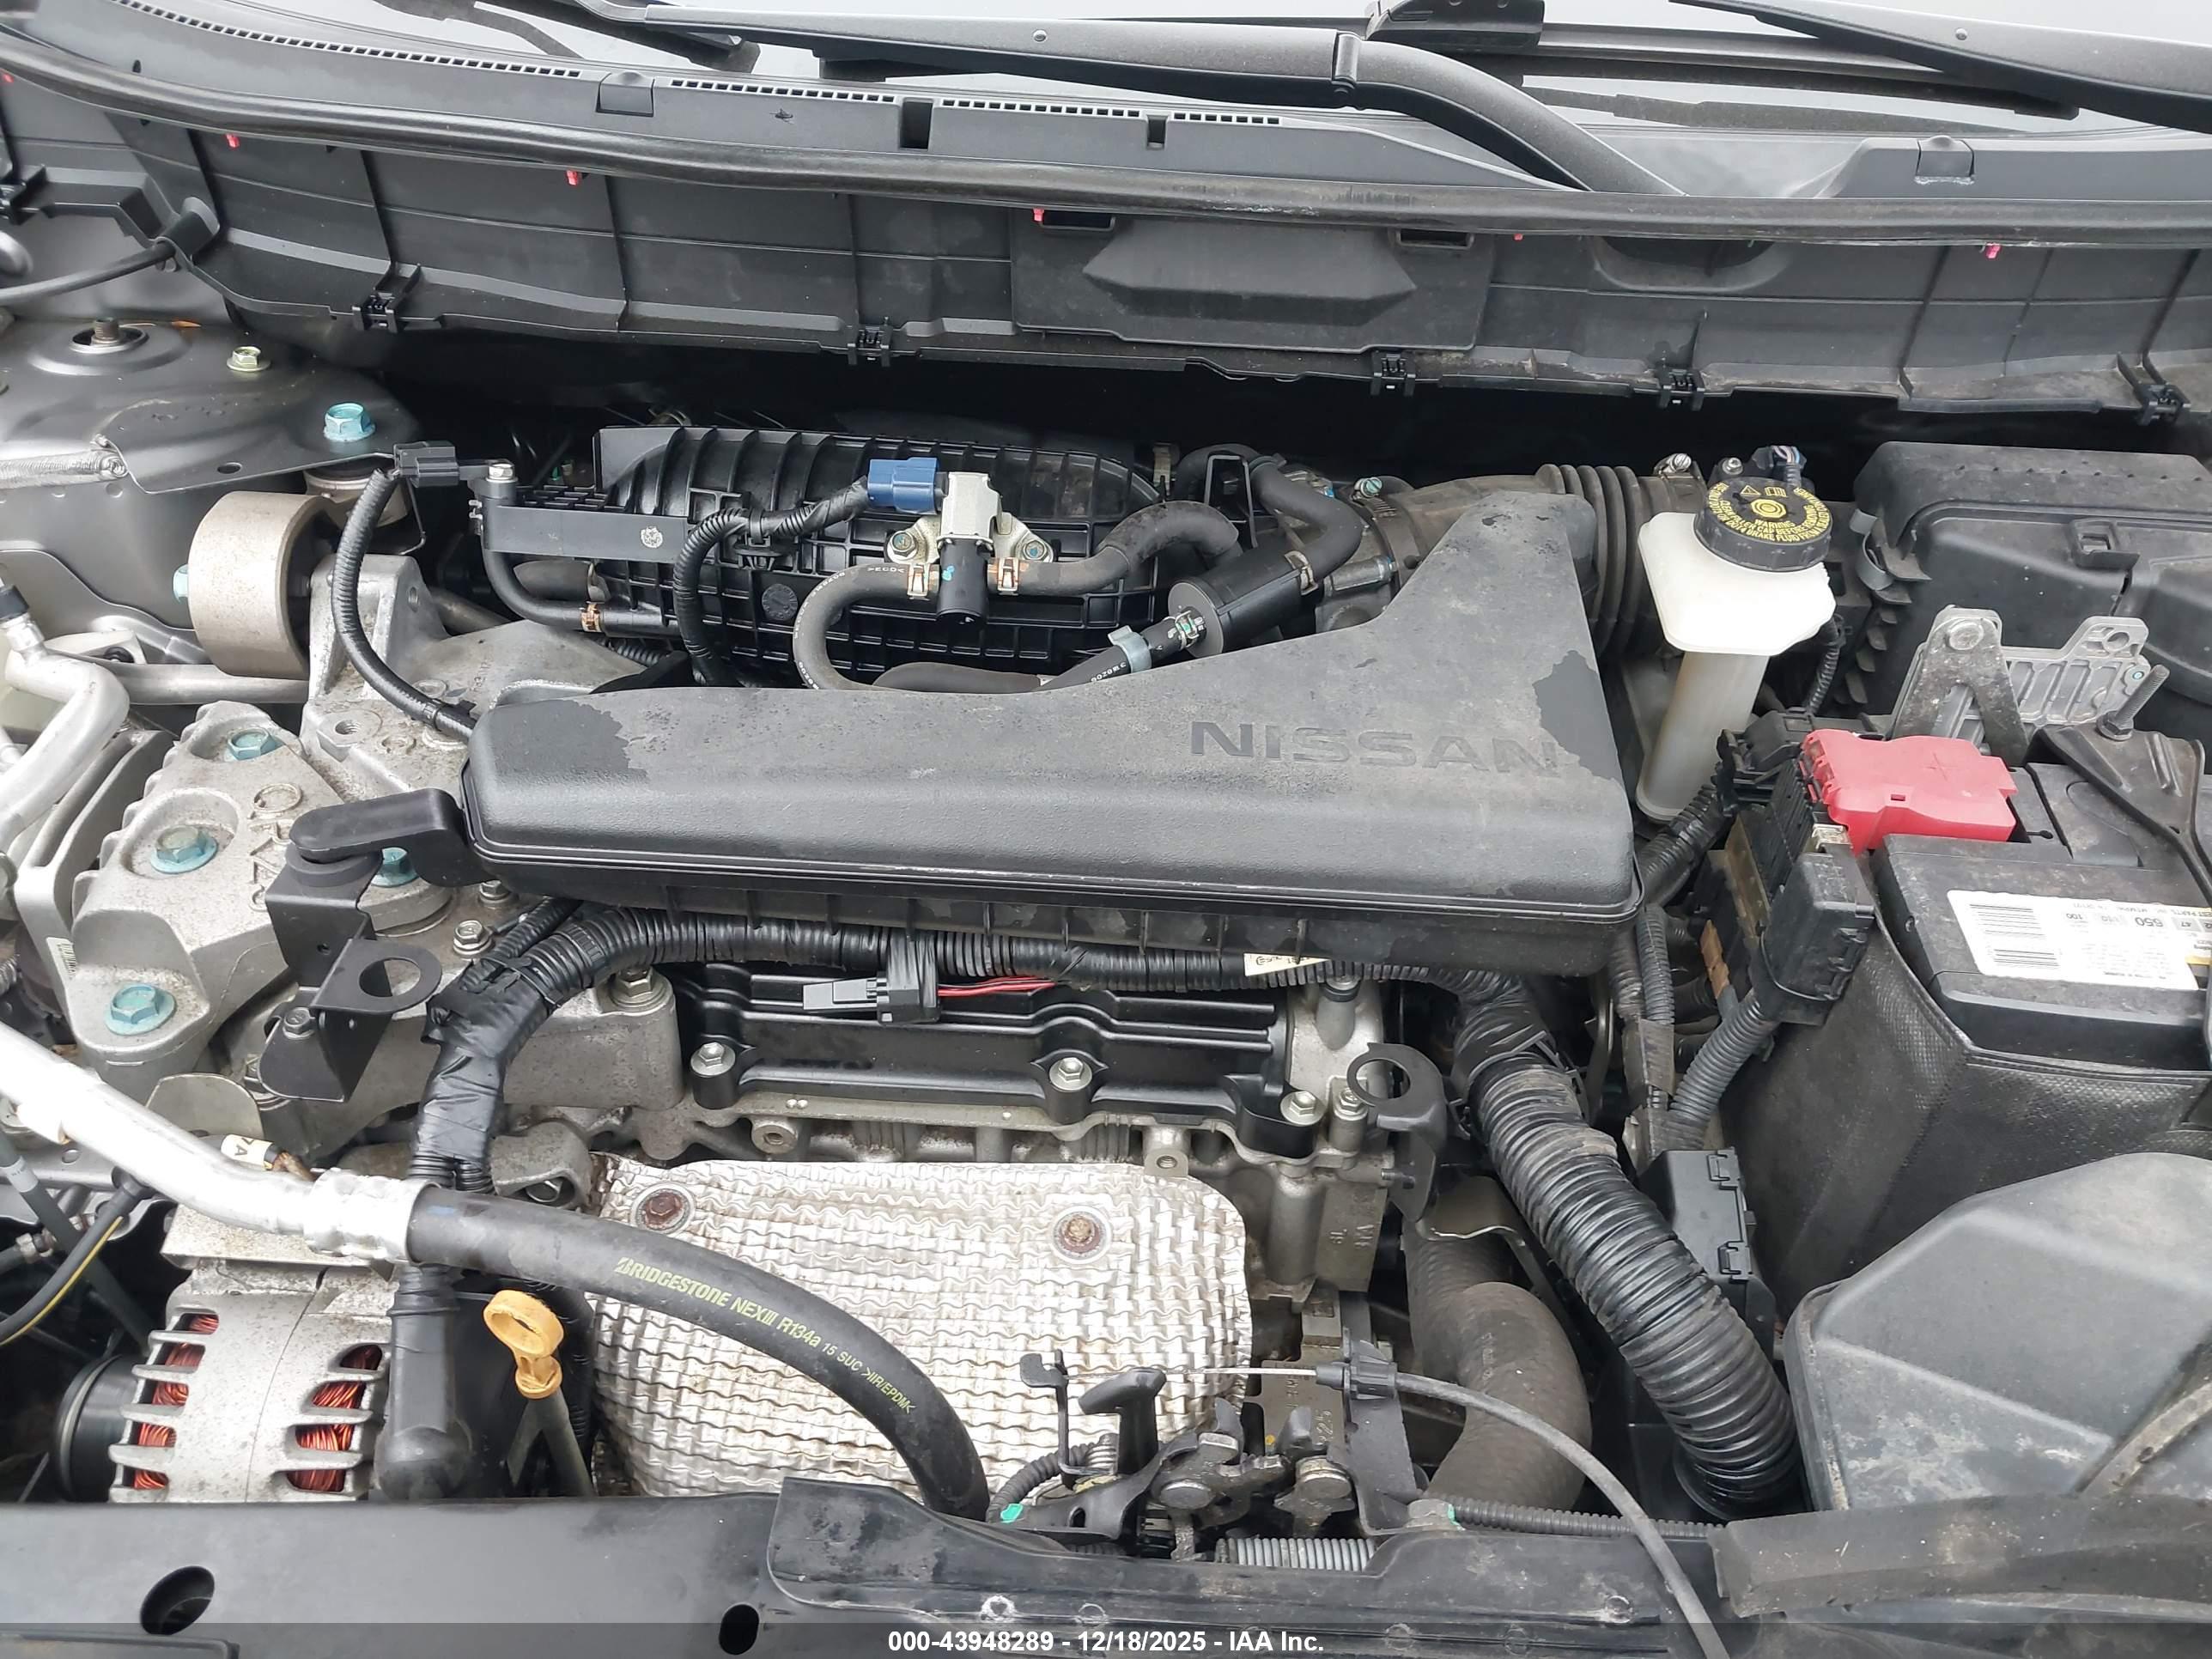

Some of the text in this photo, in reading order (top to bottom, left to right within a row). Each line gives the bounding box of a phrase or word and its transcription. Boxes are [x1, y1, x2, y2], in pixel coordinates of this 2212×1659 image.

[1754, 519, 1796, 529] WARNING
[1757, 525, 1775, 534] CAP
[1776, 524, 1805, 535] BEFORE
[1746, 529, 1775, 541] BRAKE
[1799, 530, 1817, 541] FROM
[1190, 720, 1559, 775] NISSAN
[615, 1256, 732, 1307] BRIDGESTONE
[776, 1316, 822, 1348] R134a
[822, 1341, 836, 1357] 15
[836, 1351, 864, 1372] SUC
